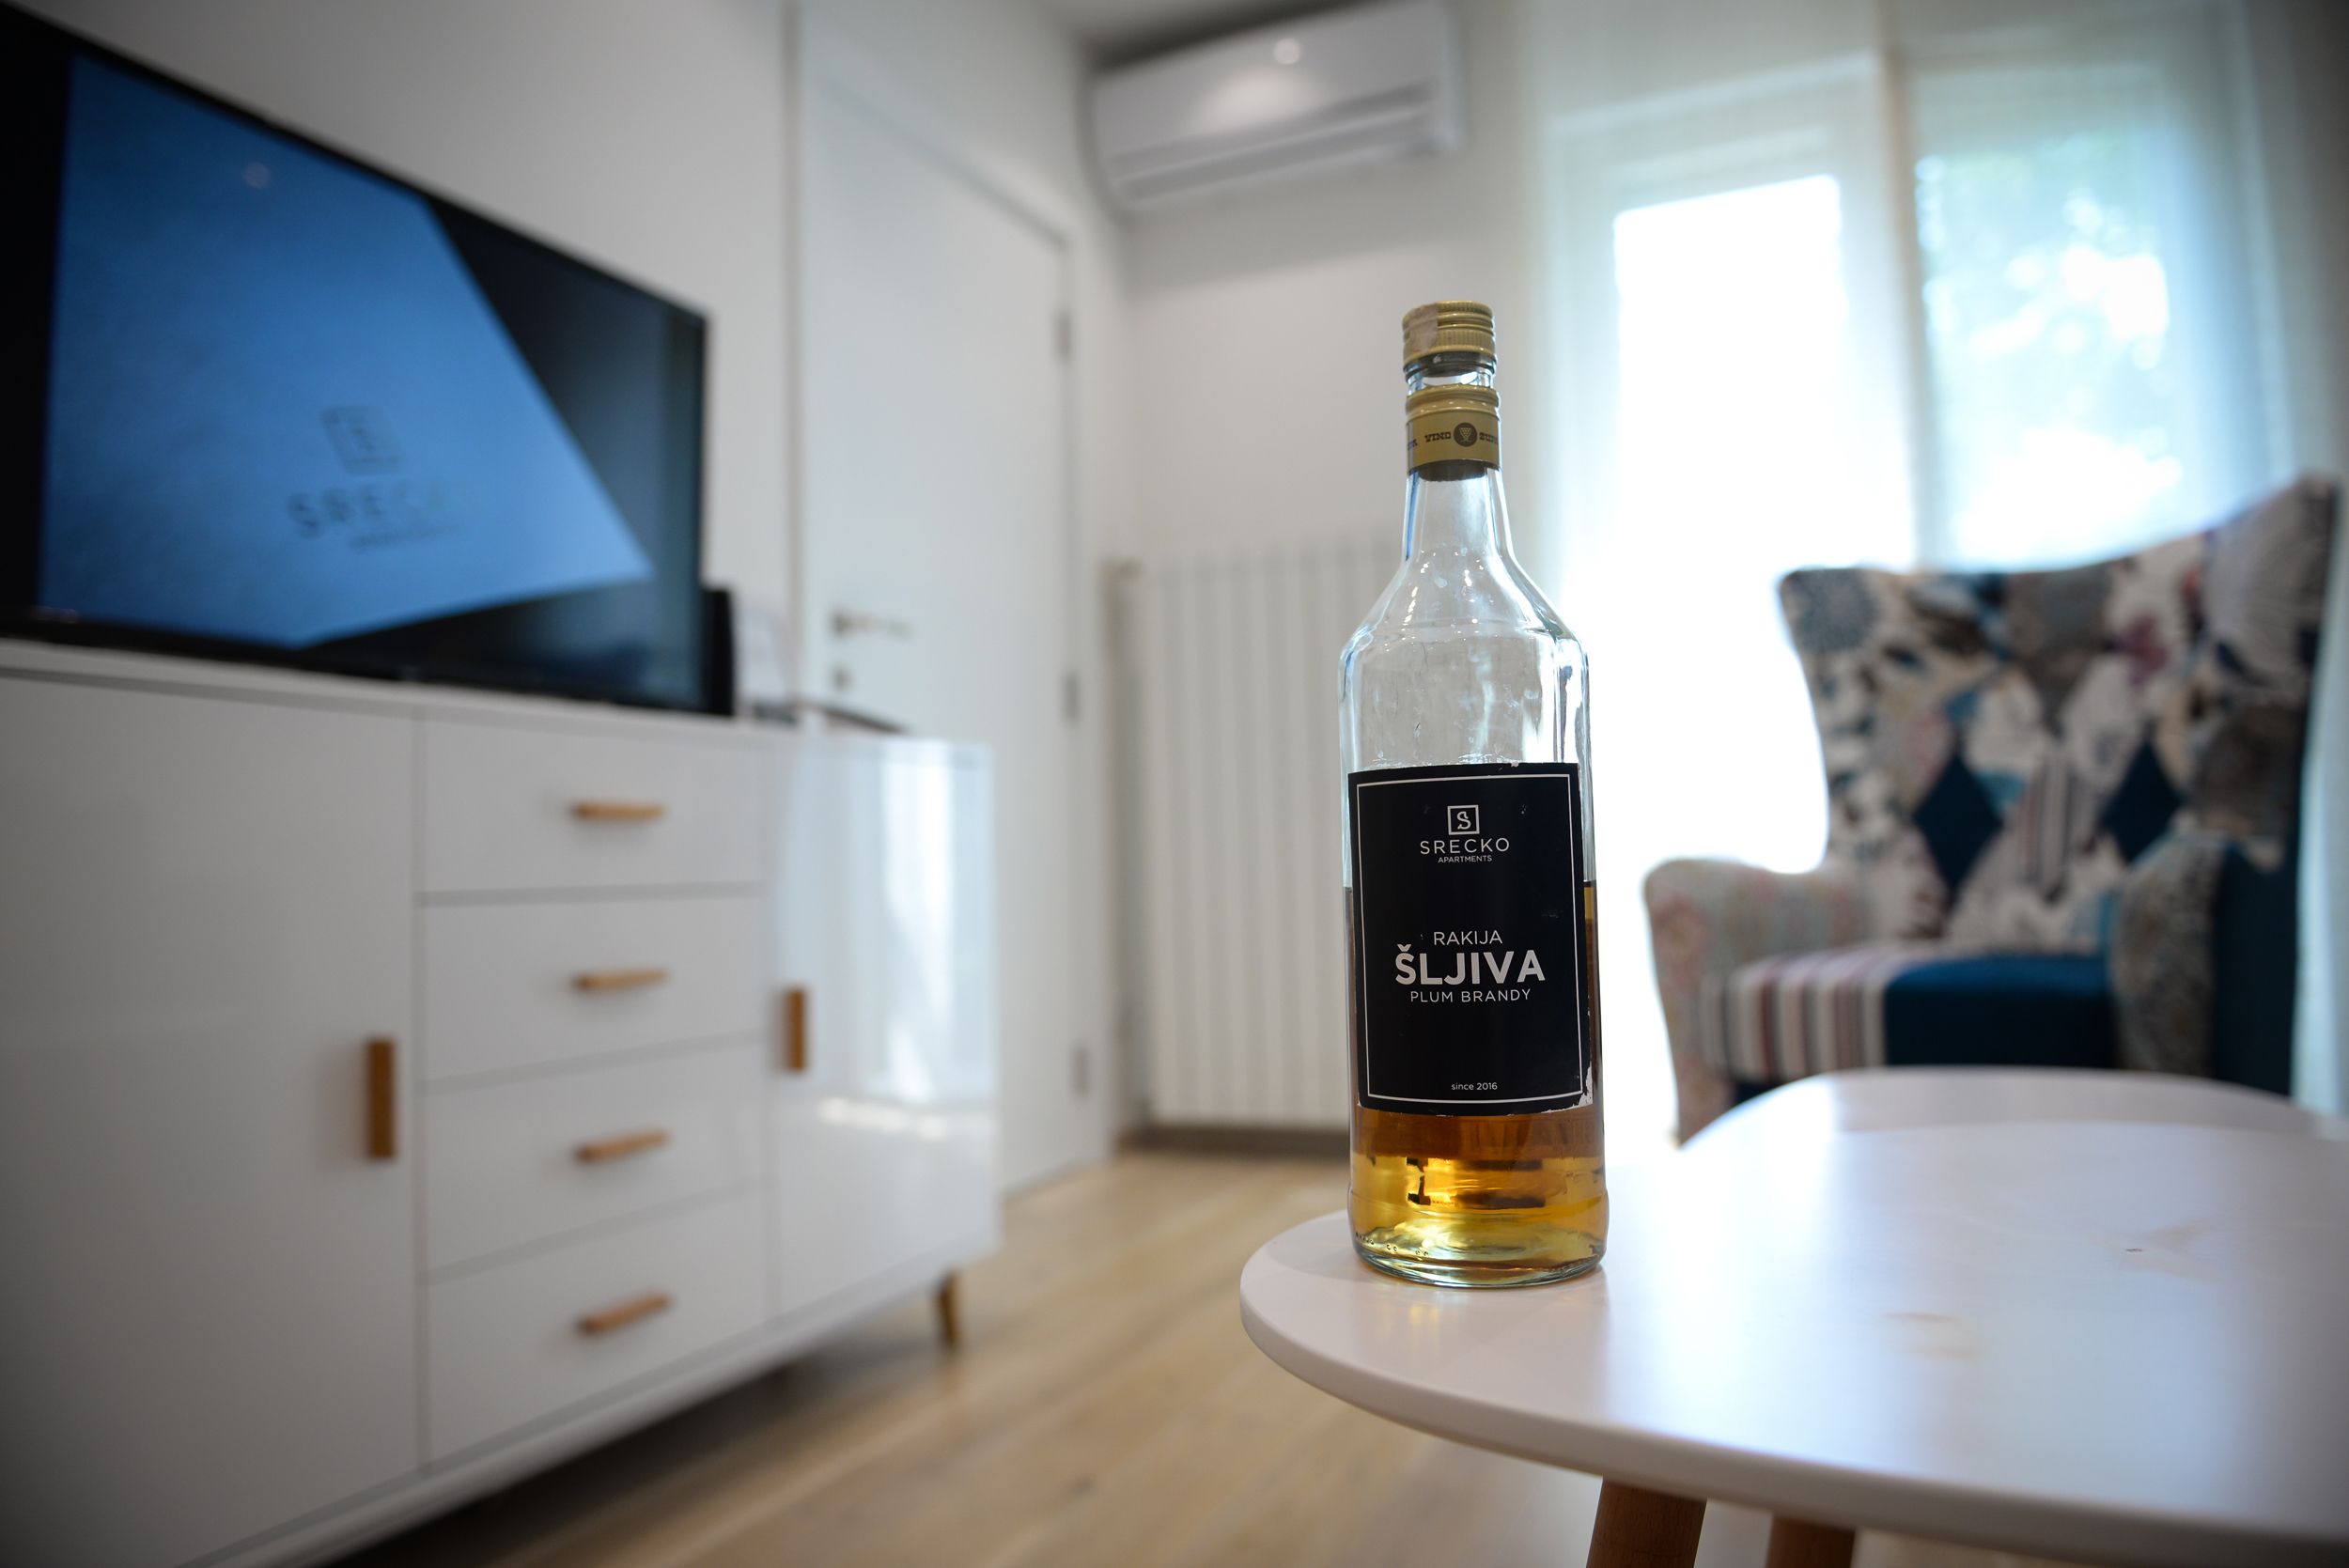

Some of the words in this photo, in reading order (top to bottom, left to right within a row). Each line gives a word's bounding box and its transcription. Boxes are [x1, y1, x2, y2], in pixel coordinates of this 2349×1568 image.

[1420, 837, 1510, 855] SRECKO
[1438, 855, 1492, 863] APARTMENTS
[1433, 929, 1503, 946] RAKIJA
[1395, 943, 1546, 986] ŠLJIVA
[1410, 990, 1454, 1003] PLUM
[1461, 988, 1531, 1003] BRANDY
[1451, 1082, 1474, 1091] since
[1476, 1081, 1498, 1091] 2016
